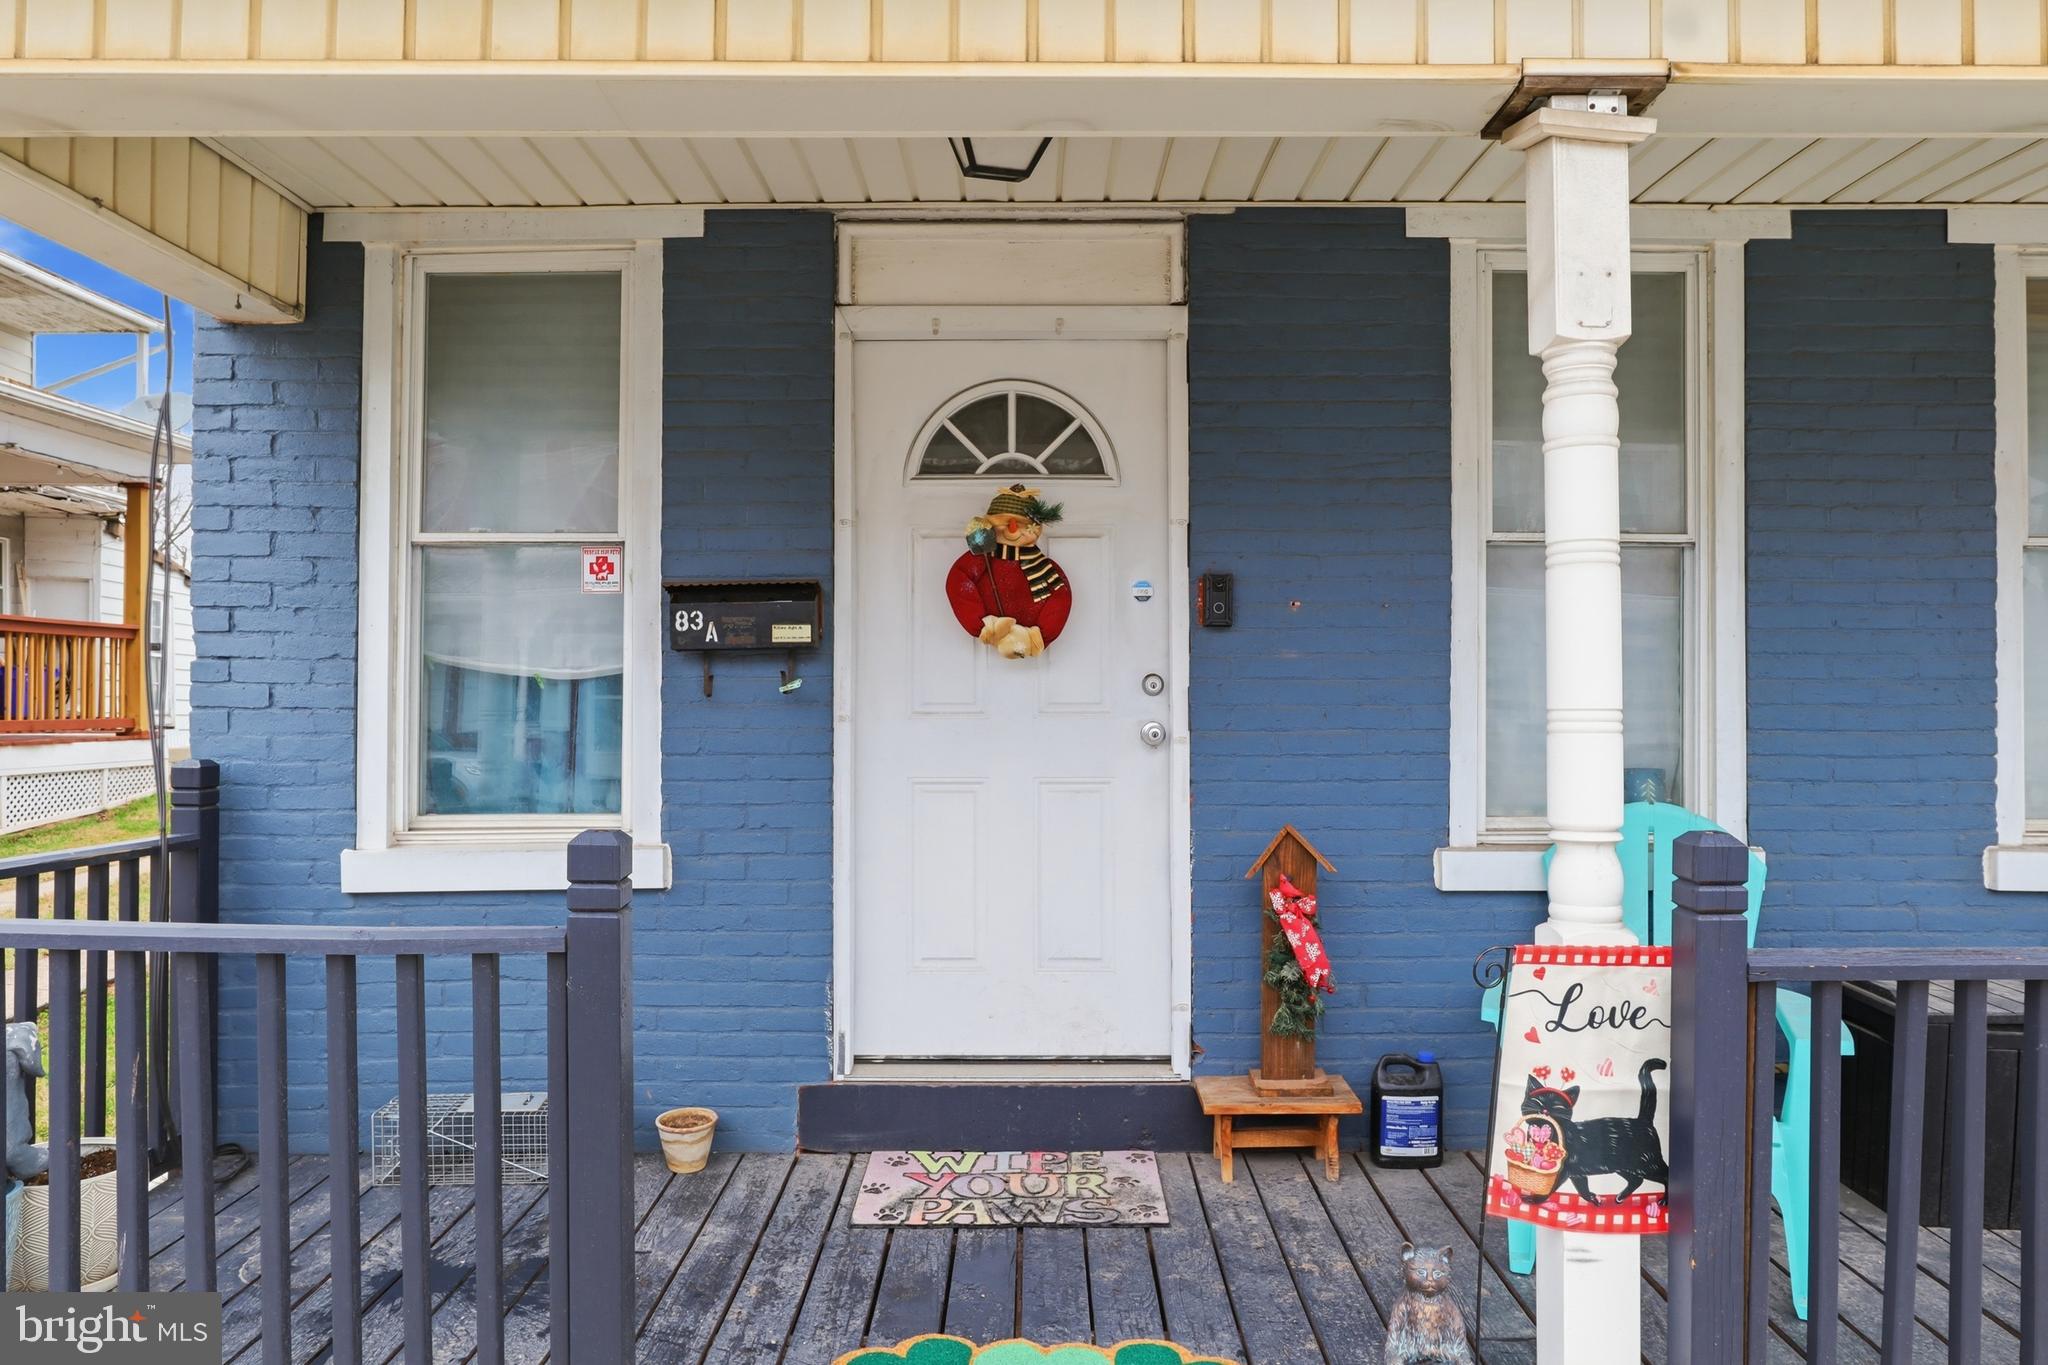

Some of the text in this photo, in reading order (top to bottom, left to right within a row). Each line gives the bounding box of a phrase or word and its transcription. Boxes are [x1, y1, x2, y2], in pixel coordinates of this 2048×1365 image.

[675, 610, 704, 632] 83
[705, 621, 719, 642] A
[1544, 982, 1652, 1033] Love
[905, 1151, 1107, 1174] WIPE
[903, 1172, 1114, 1199] YOUR
[903, 1199, 1121, 1226] PAWS
